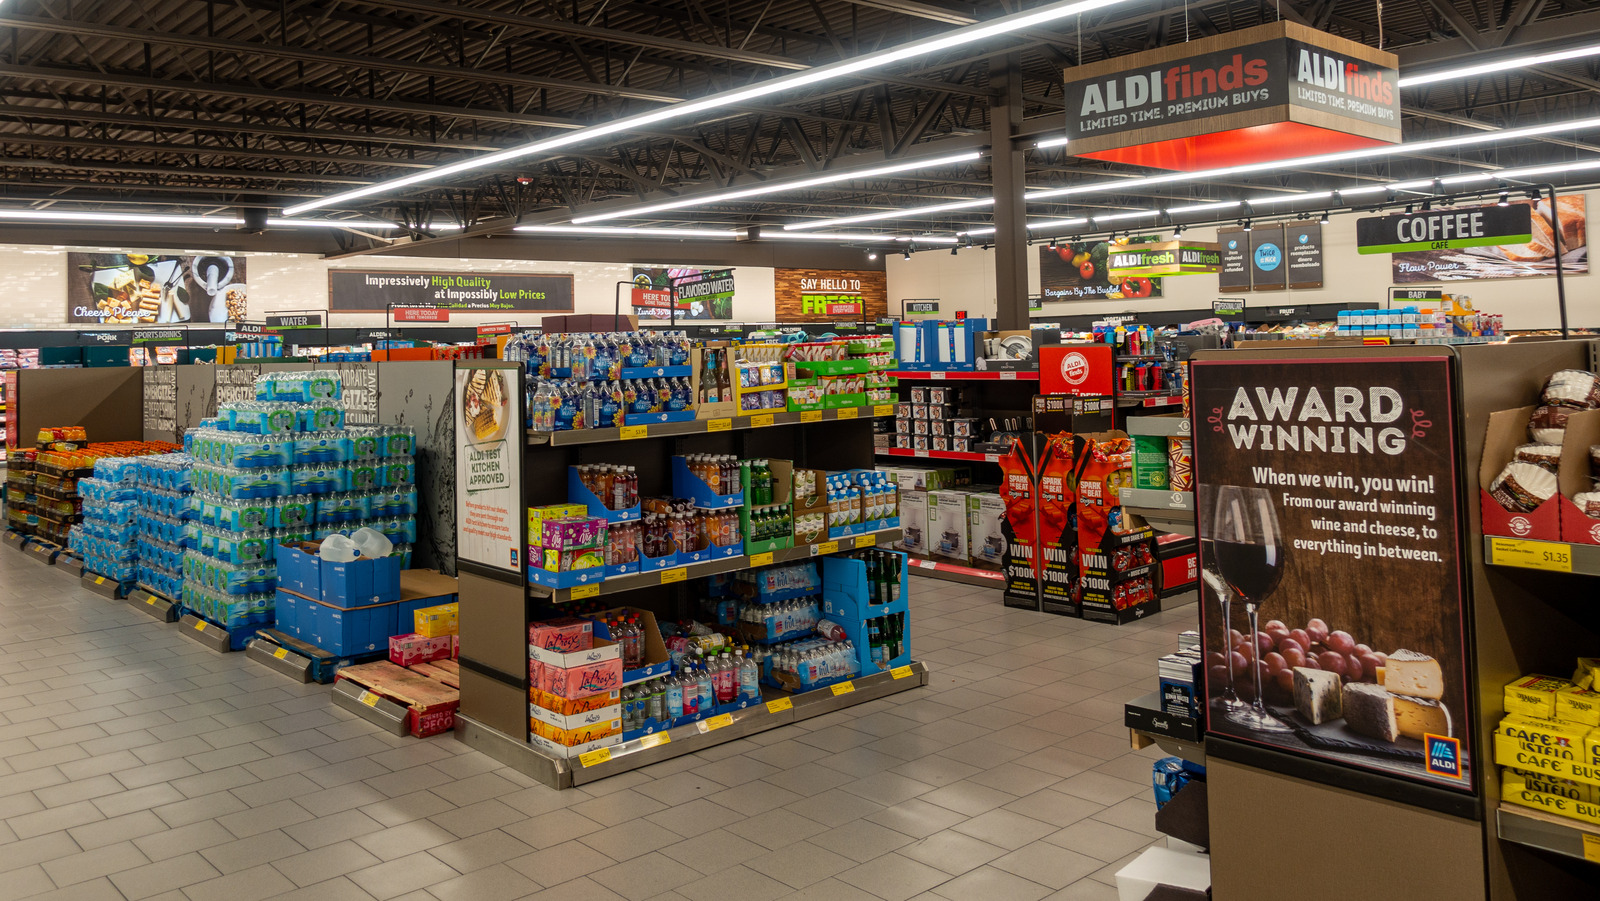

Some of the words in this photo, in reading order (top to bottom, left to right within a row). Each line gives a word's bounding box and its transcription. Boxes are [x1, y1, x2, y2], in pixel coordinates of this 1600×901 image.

[1080, 114, 1127, 132] LIMITED
[1131, 108, 1164, 121] TIME,
[1168, 96, 1229, 116] PREMIUM
[1233, 88, 1269, 104] BUYS
[1298, 87, 1327, 105] LIMITED
[1328, 94, 1347, 110] TIME,
[1347, 99, 1376, 117] PREMIUM
[1378, 106, 1394, 120] BUYS
[1397, 212, 1484, 242] COFFEE
[1431, 240, 1448, 249] CAFÉ
[1399, 263, 1426, 272] Flour
[1427, 261, 1459, 271] Power
[366, 274, 430, 289] Impressively
[432, 276, 454, 289] High
[457, 276, 491, 290] Quality
[679, 282, 710, 298] FLAVORED
[711, 279, 734, 294] WATER
[801, 279, 817, 289] SAY
[820, 279, 847, 290] HELLO
[850, 280, 860, 290] TO
[434, 289, 445, 299] at
[447, 289, 498, 302] Impossibly
[500, 290, 516, 299] Low
[519, 290, 546, 300] Prices
[1045, 288, 1073, 297] Bargains
[1074, 287, 1083, 297] By
[1083, 286, 1096, 295] The
[1097, 285, 1120, 294] Bushel
[74, 306, 111, 317] Cheese
[112, 306, 150, 317] Please
[638, 308, 655, 316] Lunch
[280, 317, 307, 326] WATER
[1067, 361, 1081, 369] ALDI
[340, 369, 367, 386] YDRATE
[217, 386, 252, 402] ENERGIZE
[368, 369, 376, 410] REVIVE
[342, 390, 367, 410] GIZE
[1227, 386, 1403, 423] AWARD
[1227, 424, 1406, 455] WINNING
[470, 451, 484, 462] ALDI
[486, 449, 501, 459] TEST
[472, 461, 500, 473] KITCHEN
[470, 473, 504, 485] APPROVED
[1009, 474, 1028, 483] SPARK
[1043, 477, 1062, 486] SPARK
[1080, 481, 1101, 489] SPARK
[1252, 466, 1296, 486] When
[1299, 474, 1321, 487] we
[1324, 472, 1359, 492] win,
[1362, 477, 1393, 495] you
[1396, 475, 1434, 494] win!
[1283, 493, 1313, 508] From
[1315, 497, 1335, 510] our
[1338, 498, 1378, 512] award
[1380, 502, 1436, 521] winning
[1311, 518, 1341, 531] wine
[1343, 519, 1367, 534] and
[1369, 521, 1420, 540] cheese,
[1422, 525, 1438, 540] to
[1010, 544, 1033, 558] WIN
[1044, 548, 1066, 563] WIN
[1294, 538, 1362, 559] everything
[1364, 544, 1376, 556] in
[1378, 543, 1442, 563] between.
[1543, 551, 1568, 563] $1.35
[1082, 554, 1107, 569] WIN
[1009, 565, 1035, 579] $100K
[1043, 569, 1069, 584] $100K
[1081, 576, 1110, 590] $100K
[1519, 742, 1574, 760] USTELO
[1431, 758, 1456, 770] ALDI
[1525, 778, 1580, 800] USTELO
[1576, 804, 1600, 818] BU
